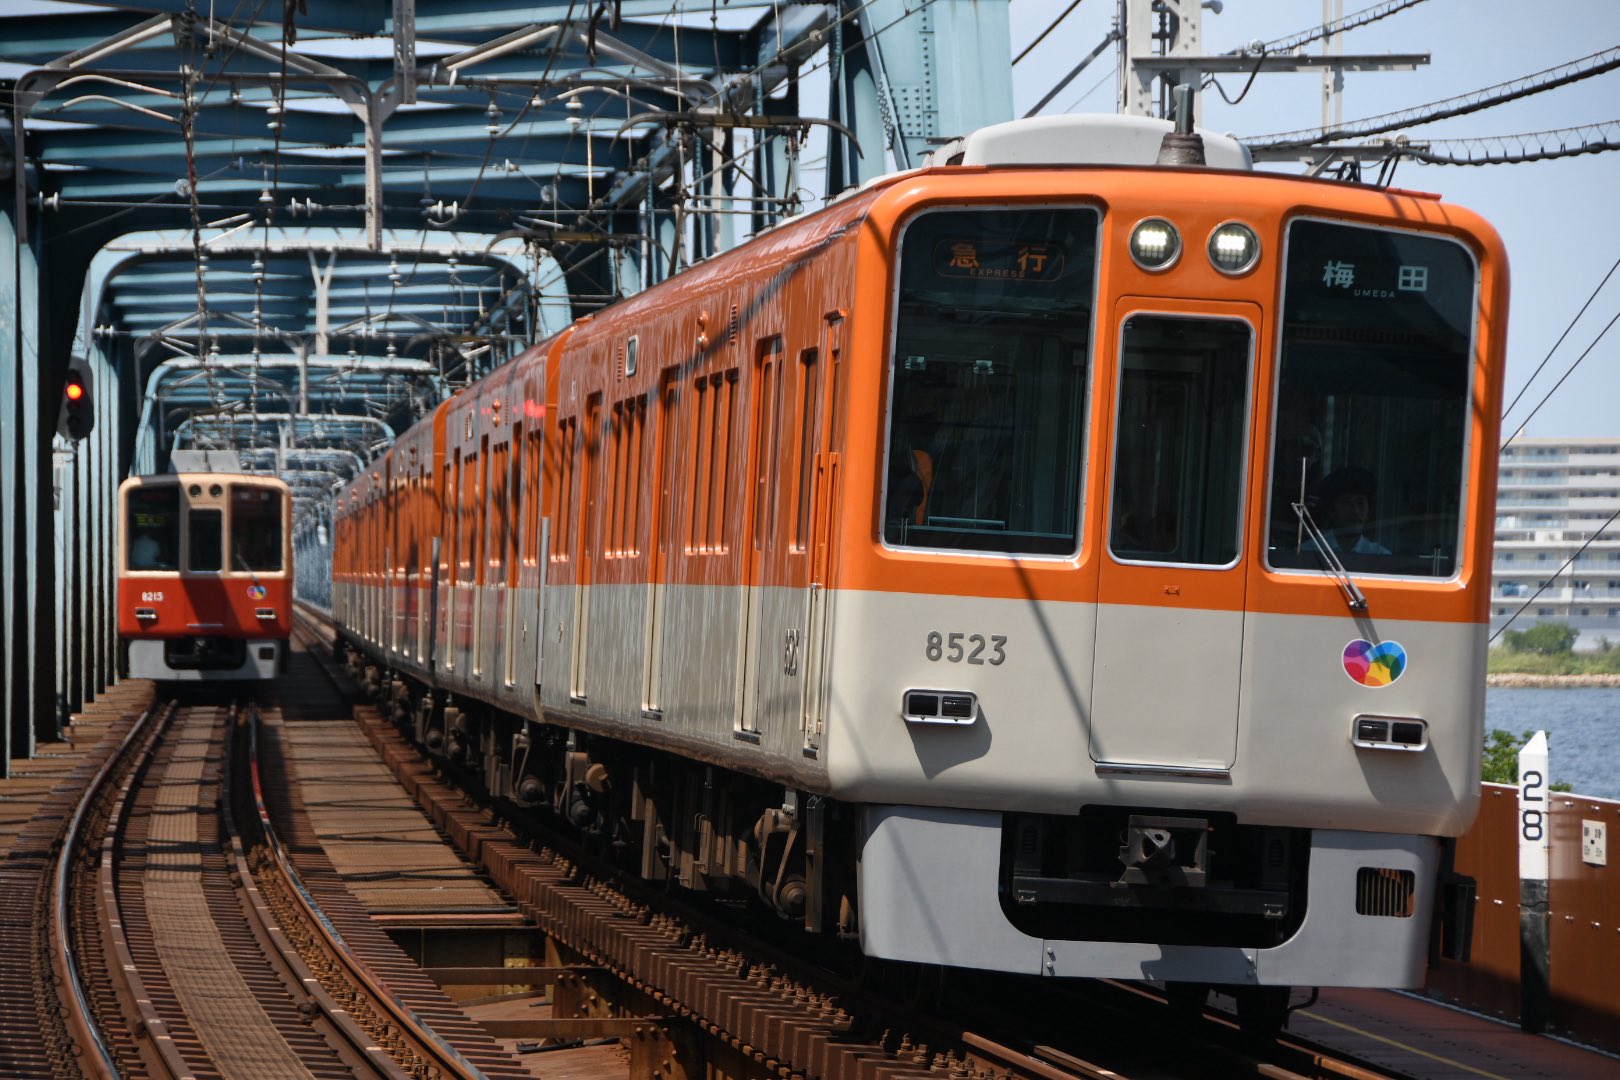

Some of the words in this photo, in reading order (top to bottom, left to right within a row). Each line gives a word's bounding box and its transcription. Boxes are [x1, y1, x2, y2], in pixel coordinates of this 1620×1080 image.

[950, 243, 1048, 272] 急行
[970, 268, 1025, 279] EXPRESS
[1322, 260, 1428, 291] 梅田
[1354, 289, 1396, 298] UMEDA
[926, 630, 1008, 666] 8523
[1522, 771, 1543, 841] 28
